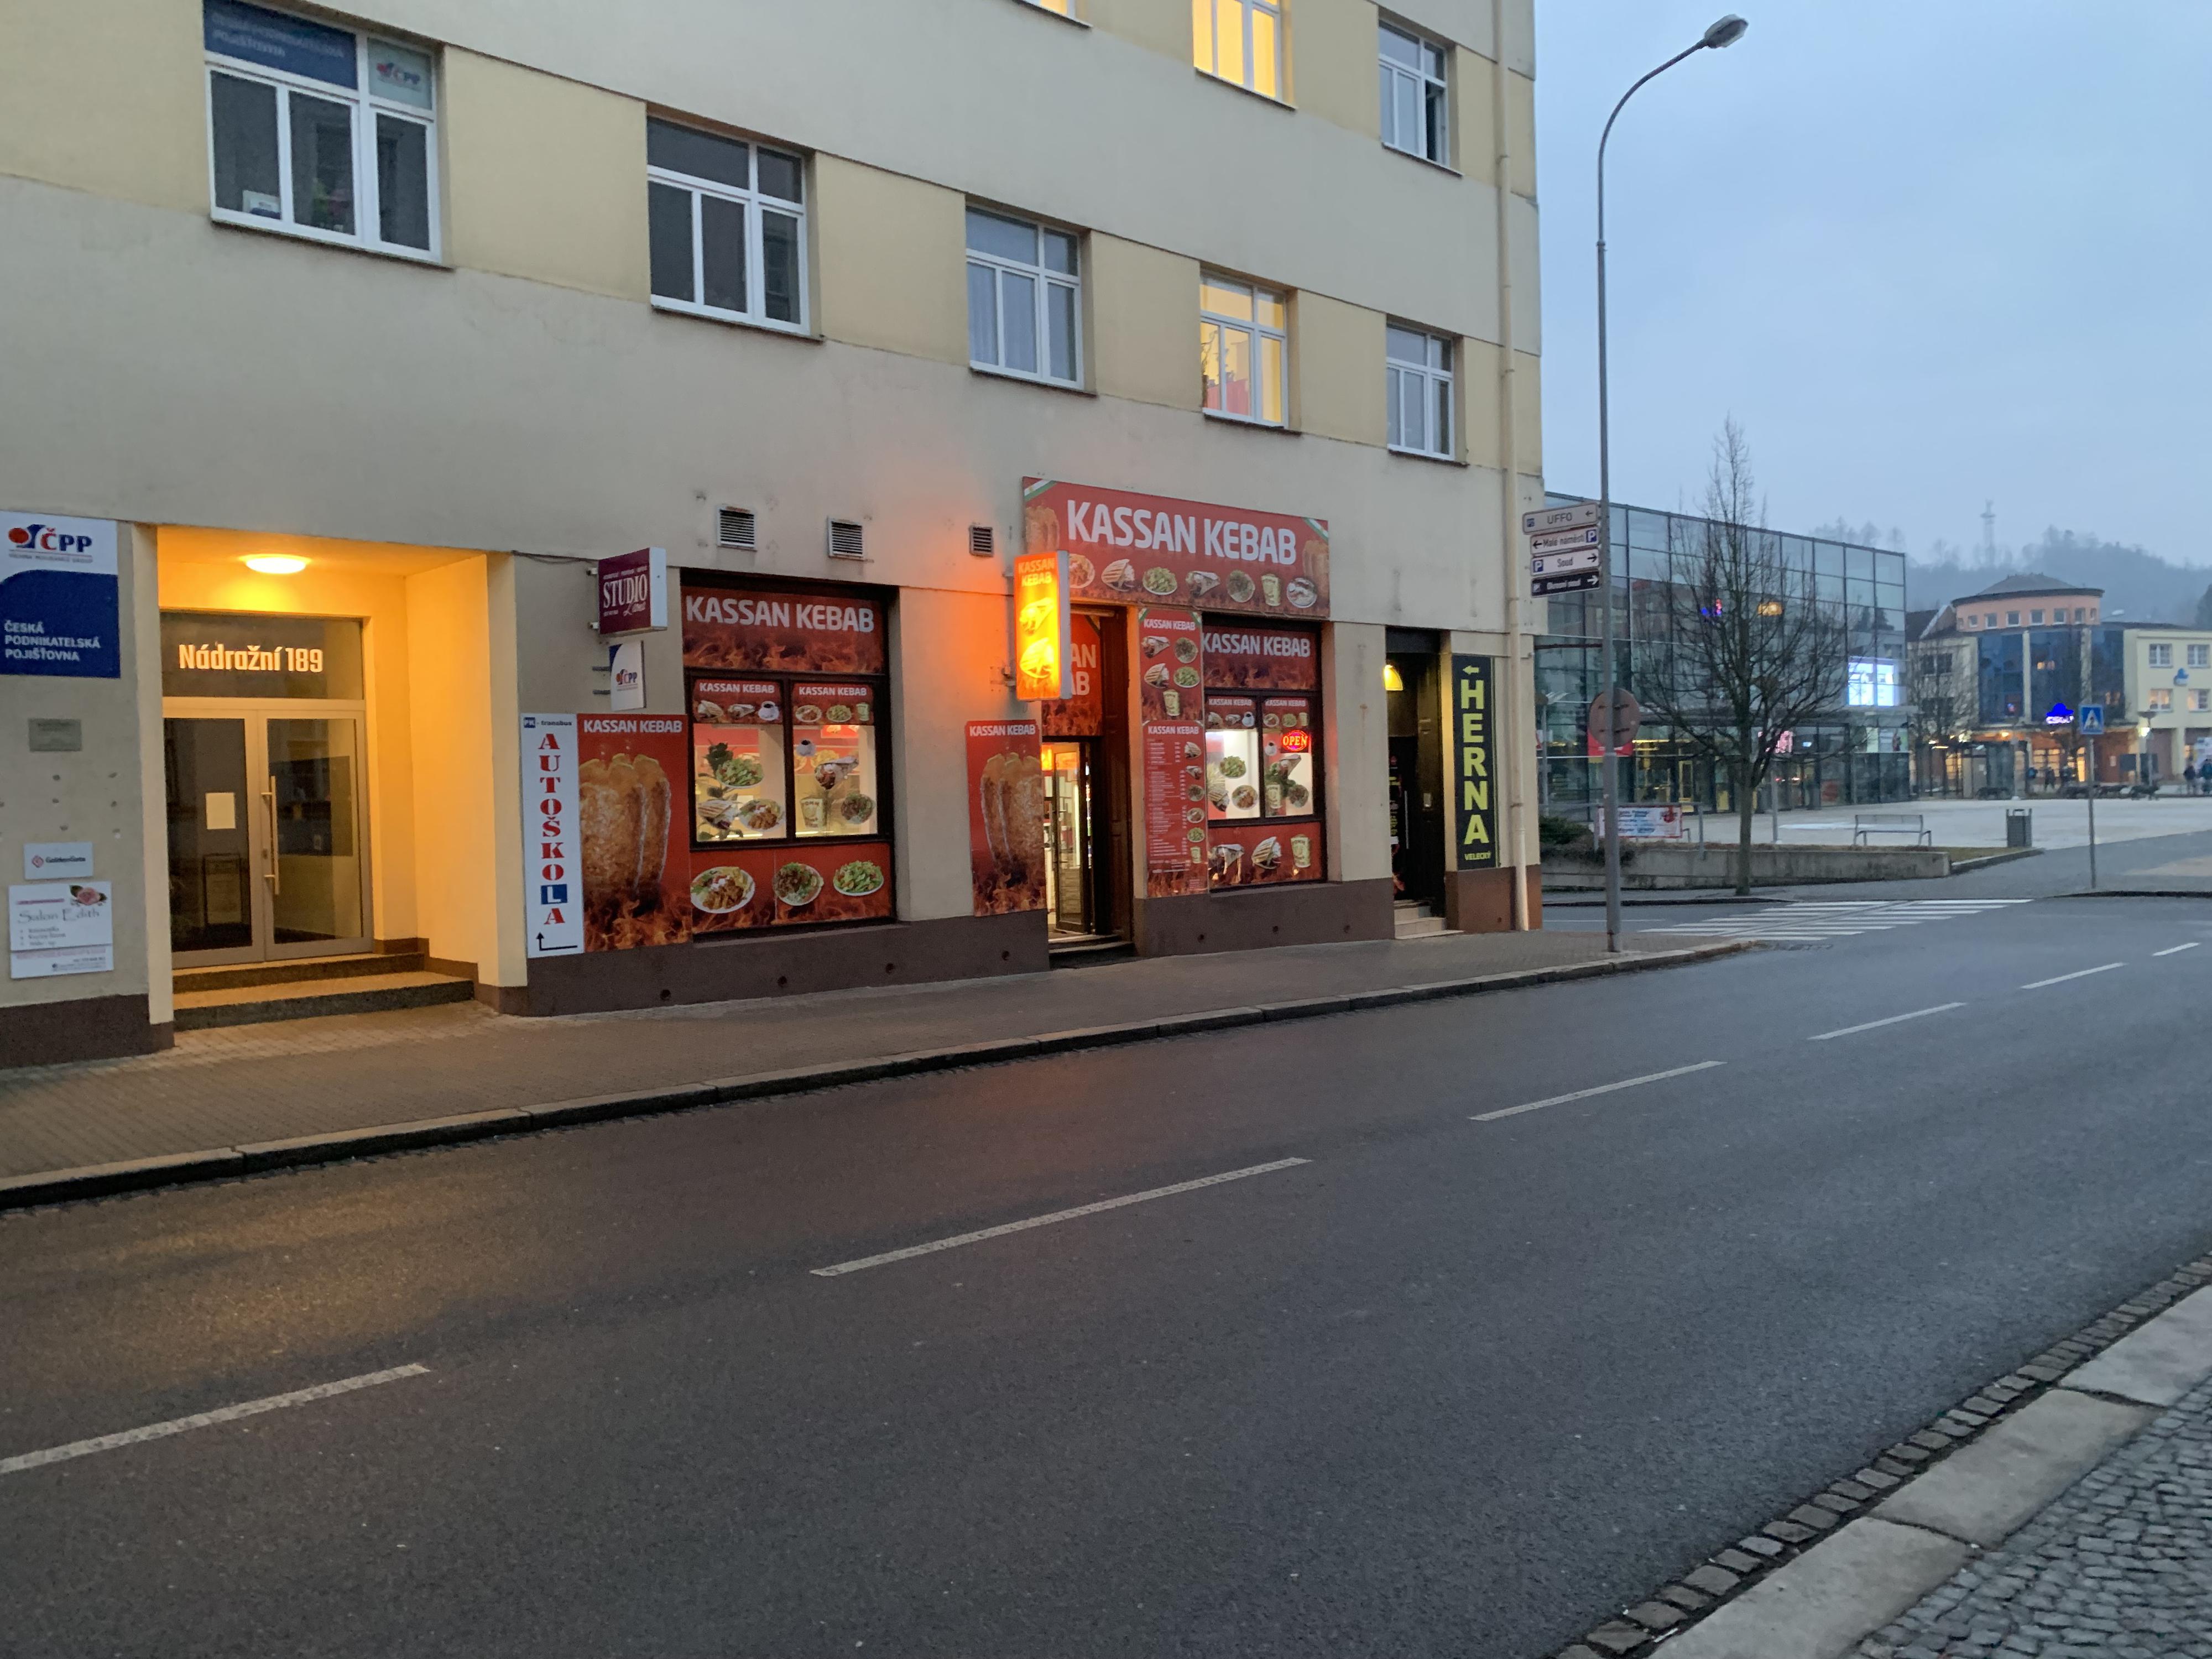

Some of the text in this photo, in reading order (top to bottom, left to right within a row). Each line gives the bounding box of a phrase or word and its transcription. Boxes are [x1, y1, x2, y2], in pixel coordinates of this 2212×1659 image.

[1547, 512, 1573, 524] UFFO
[1067, 499, 1296, 565] KASSAN KEBAB
[40, 528, 93, 552] ČPP
[1018, 557, 1056, 574] KASSAN
[1557, 557, 1574, 568] Soud
[1021, 572, 1052, 587] KEBAB
[603, 573, 648, 609] STUDIO
[685, 595, 875, 633] KASSAN KEBAB
[4, 620, 44, 634] ČESKÁ
[1144, 619, 1196, 631] KASSAN KEBAB
[5, 635, 101, 649] PODNIKATELSKÁ
[1202, 632, 1311, 658] KASSAN KEBAB
[5, 648, 80, 661] POJIŠŤOVNA
[178, 643, 324, 673] Nádražní 189
[699, 682, 775, 694] KASSAN KEBAB
[799, 686, 867, 696] KASSAN KEBAB
[1208, 698, 1252, 707] KASSAN KEBAB
[583, 719, 683, 733] KASSAN KEBAB
[969, 724, 1036, 737] KASSAN KEBAB
[1147, 726, 1199, 735] KASSAN KEBAB
[1282, 735, 1308, 748] OPEN
[1460, 679, 1489, 845] HERNA
[538, 733, 566, 925] AUTOŠKOLA
